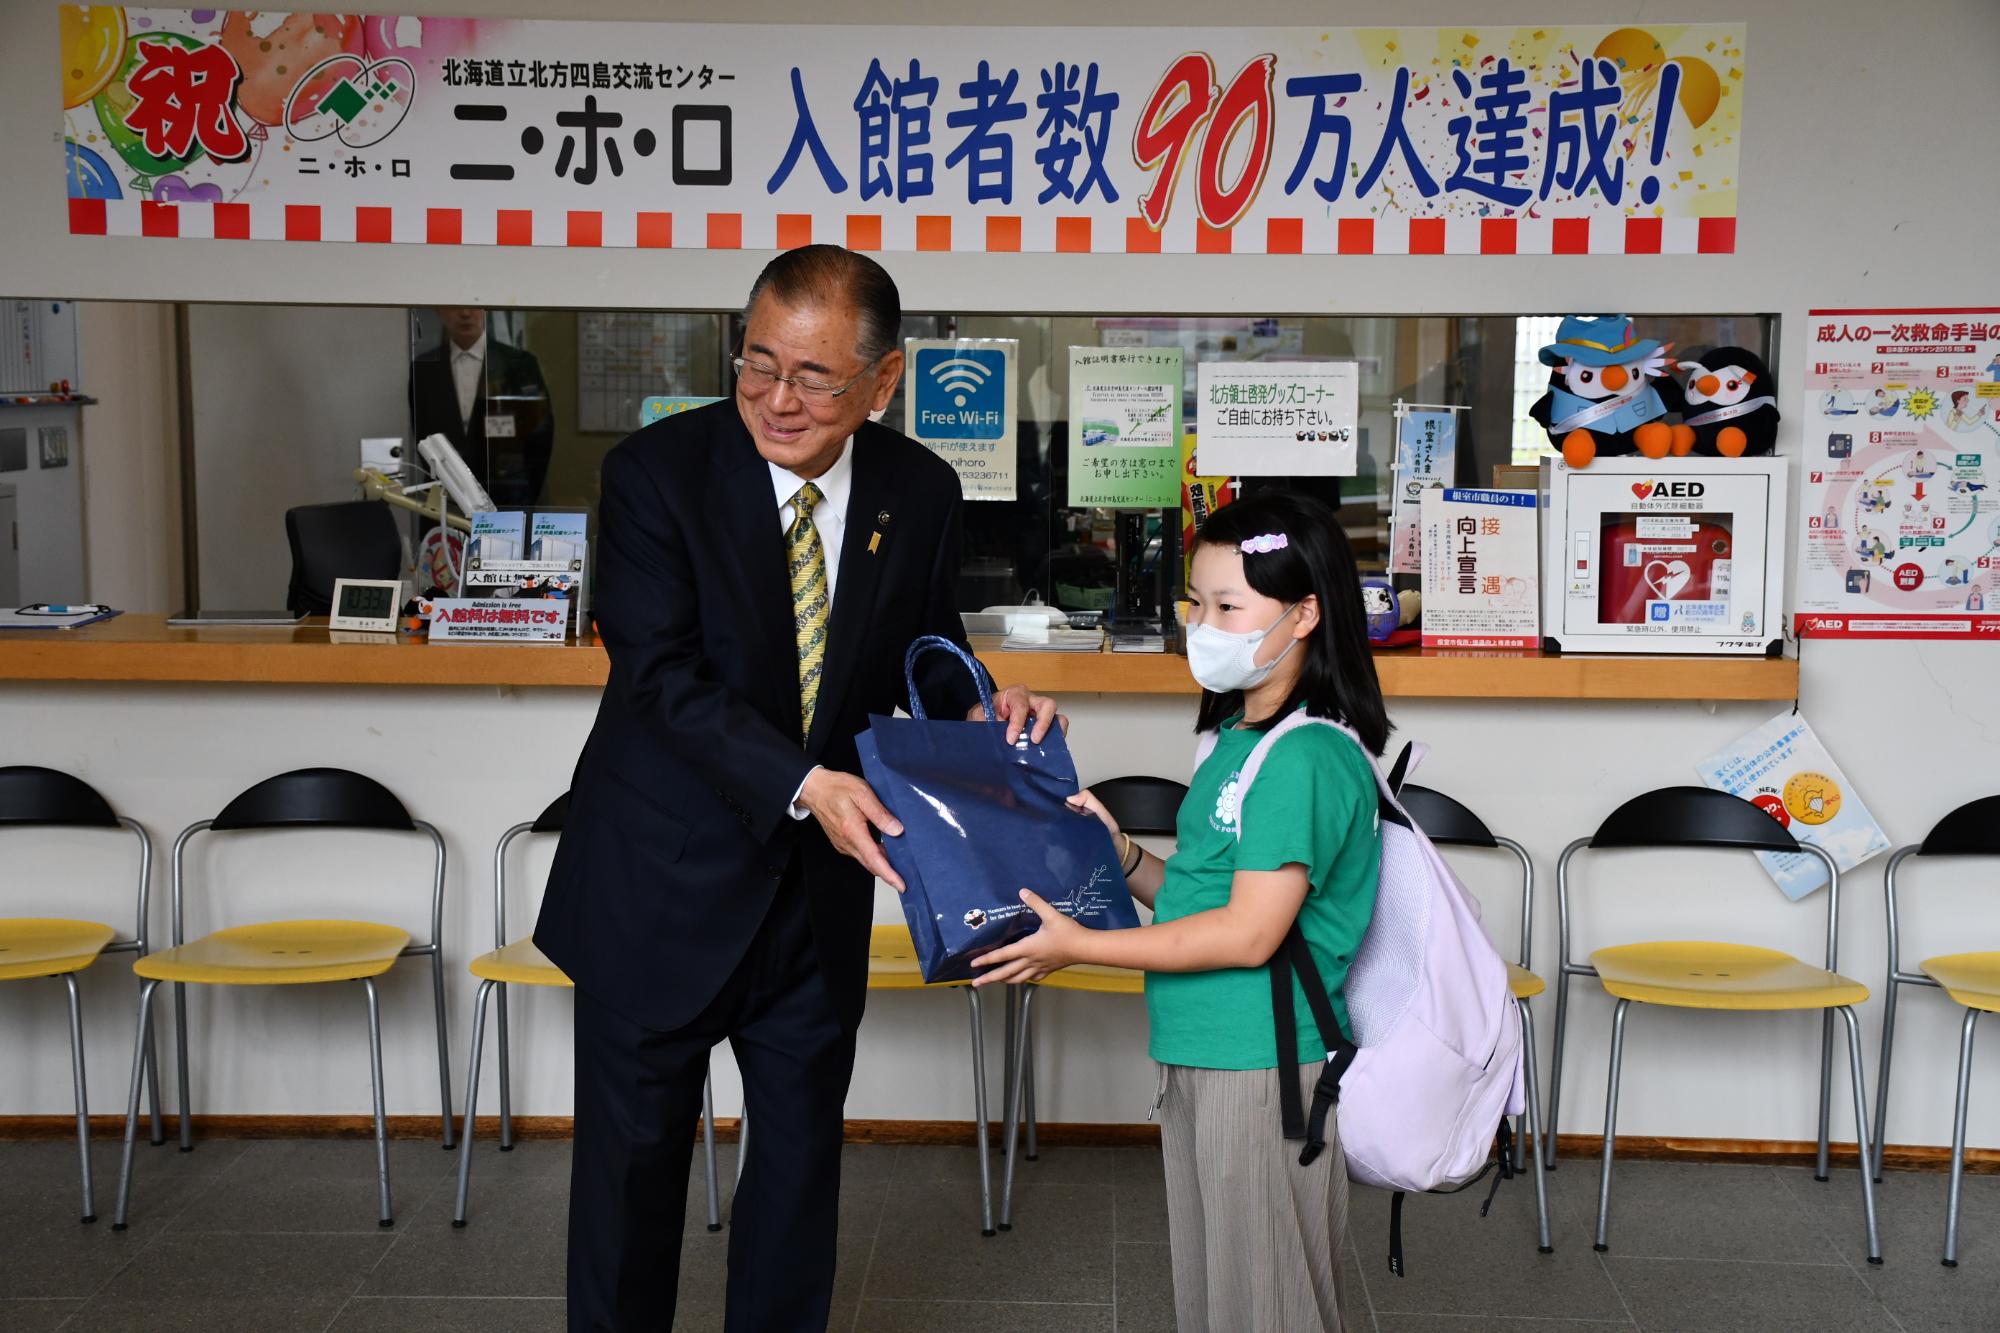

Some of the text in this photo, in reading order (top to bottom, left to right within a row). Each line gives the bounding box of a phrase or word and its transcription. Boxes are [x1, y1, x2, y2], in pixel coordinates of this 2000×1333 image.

[442, 58, 736, 91] 北海道立北方四島交流センター
[123, 41, 252, 162] 祝
[1817, 322, 2000, 342] 成人の一次救命手当の
[1209, 383, 1335, 405] 北方領土啓発グッズコーナー
[922, 410, 998, 425] Free Wi-Fi
[1217, 408, 1336, 427] ご自由にお持ち下さい。
[1424, 419, 1436, 474] 根室さんま
[1082, 457, 1176, 468] ご希望の方は窓口まで
[1094, 469, 1164, 479] お申し出下さい。
[1652, 482, 1705, 498] AED
[1631, 502, 1704, 510] 自動体外式除細動器
[1456, 516, 1477, 595] 向上宣言
[435, 608, 565, 625] 入館料は無料です。
[1816, 620, 1843, 628] AED
[1758, 786, 1777, 794] NEW
